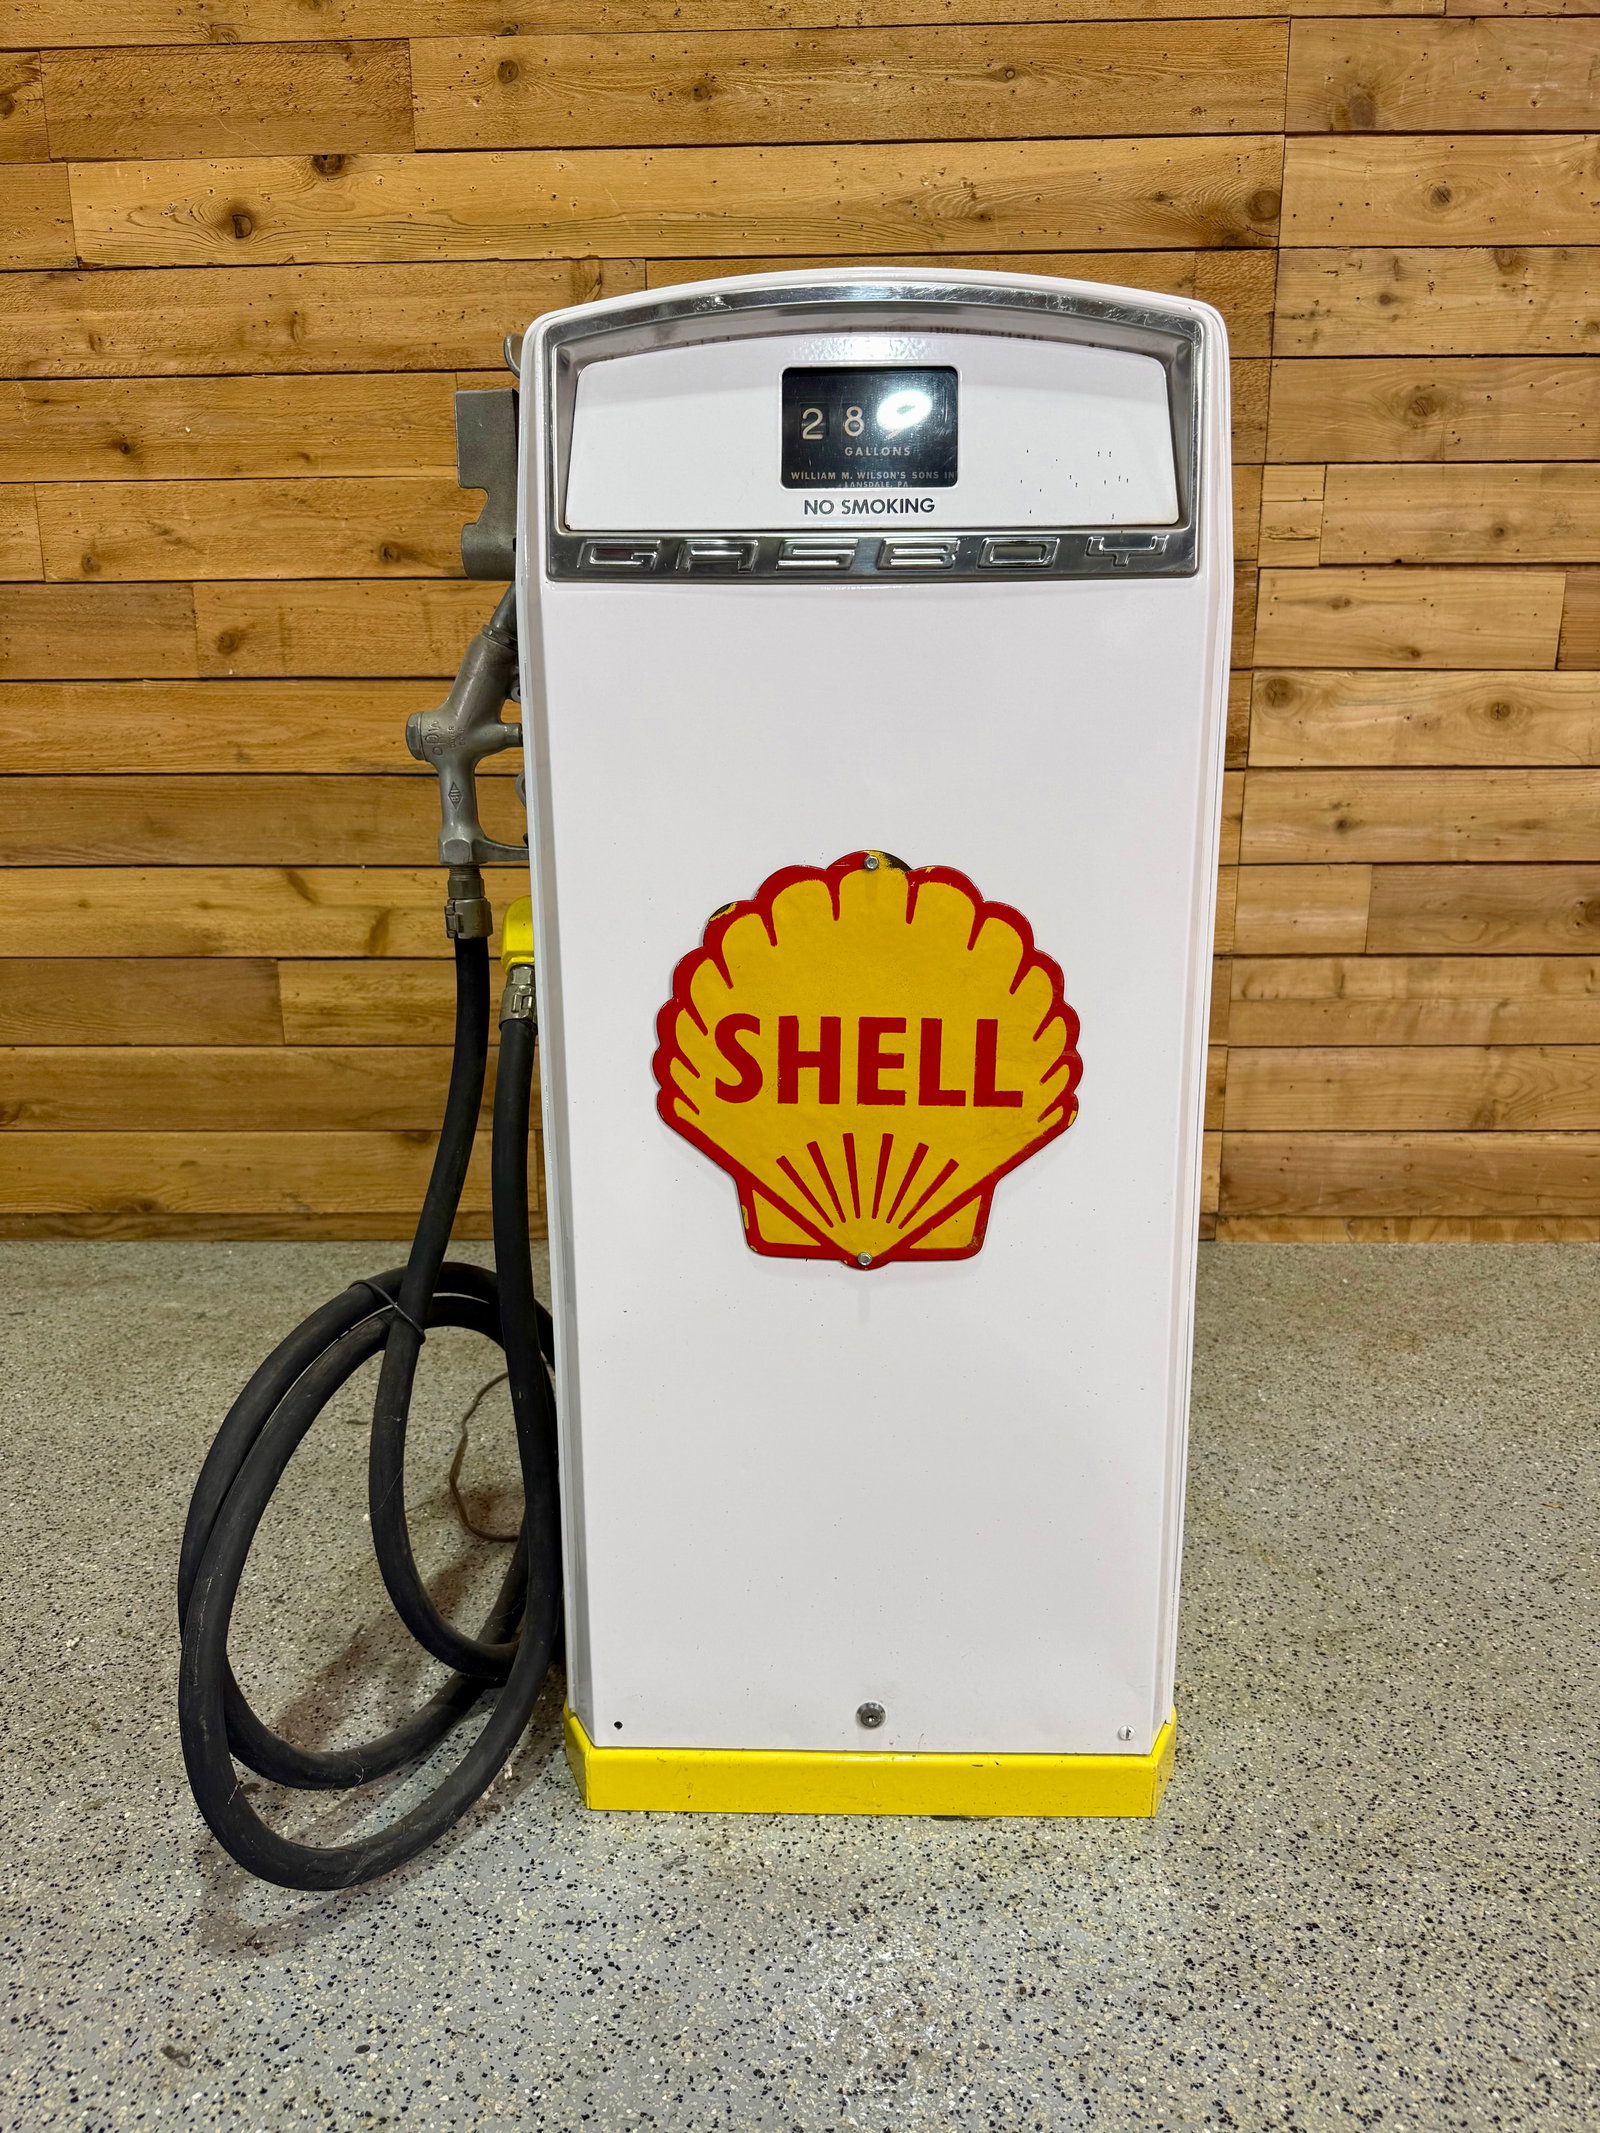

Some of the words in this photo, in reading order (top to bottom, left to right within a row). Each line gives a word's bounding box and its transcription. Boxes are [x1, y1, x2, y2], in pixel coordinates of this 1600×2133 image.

[844, 446, 911, 456] GALLONS
[791, 472, 836, 480] WILLIAM
[841, 472, 853, 480] M.
[857, 471, 906, 480] WILSON'S
[912, 471, 939, 479] SONS
[944, 471, 958, 479] IN
[804, 499, 835, 515] NO
[841, 498, 936, 515] SMOKING
[577, 536, 1169, 572] GASBOY
[714, 1013, 1023, 1107] SHELL
